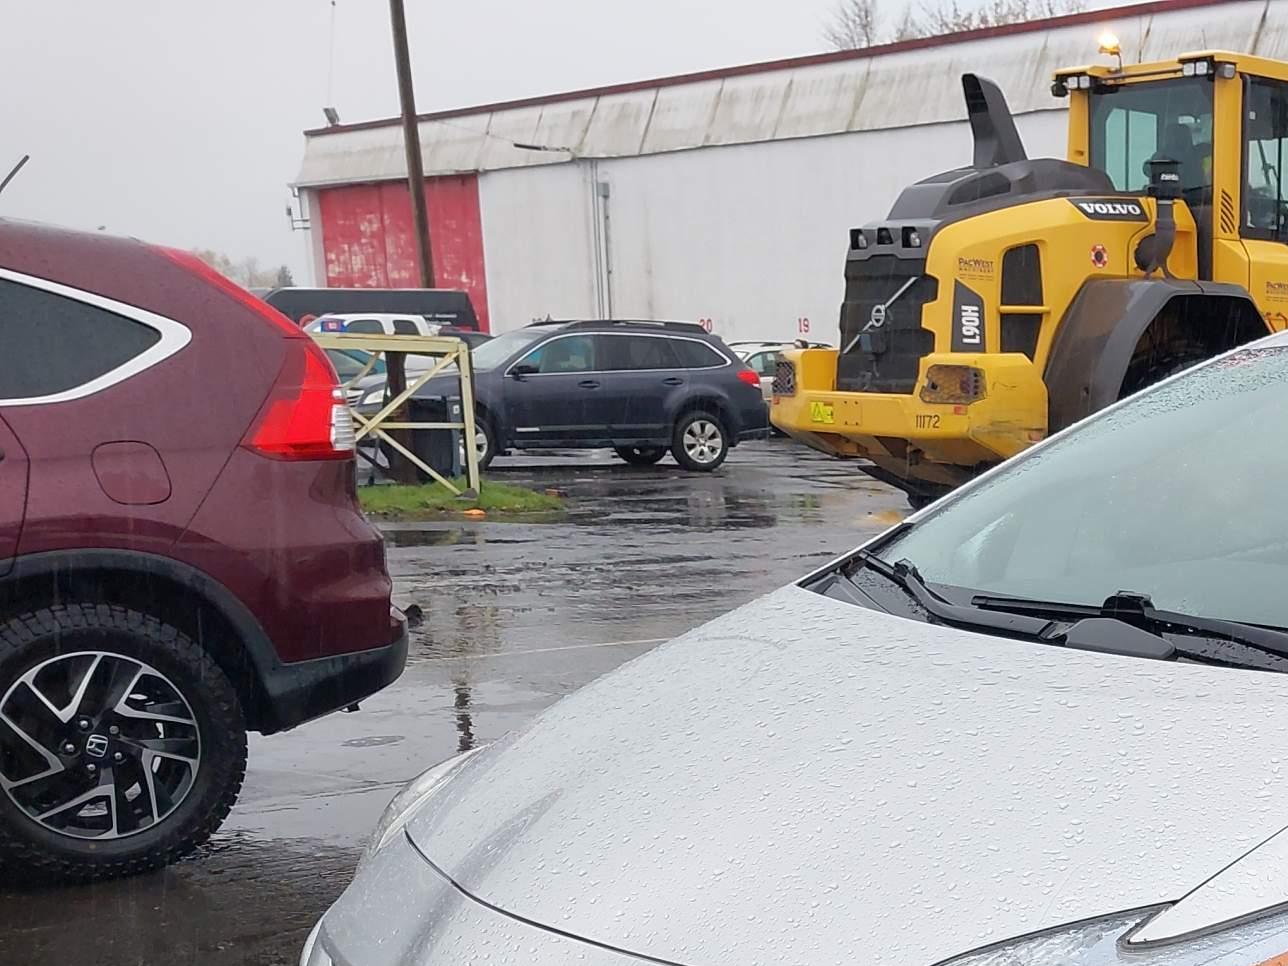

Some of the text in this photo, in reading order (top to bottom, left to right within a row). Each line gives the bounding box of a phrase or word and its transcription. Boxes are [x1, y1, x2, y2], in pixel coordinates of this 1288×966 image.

[1079, 203, 1141, 216] VOLVO
[798, 317, 810, 333] 19
[961, 304, 981, 345] L90H
[915, 414, 941, 429] 11172
